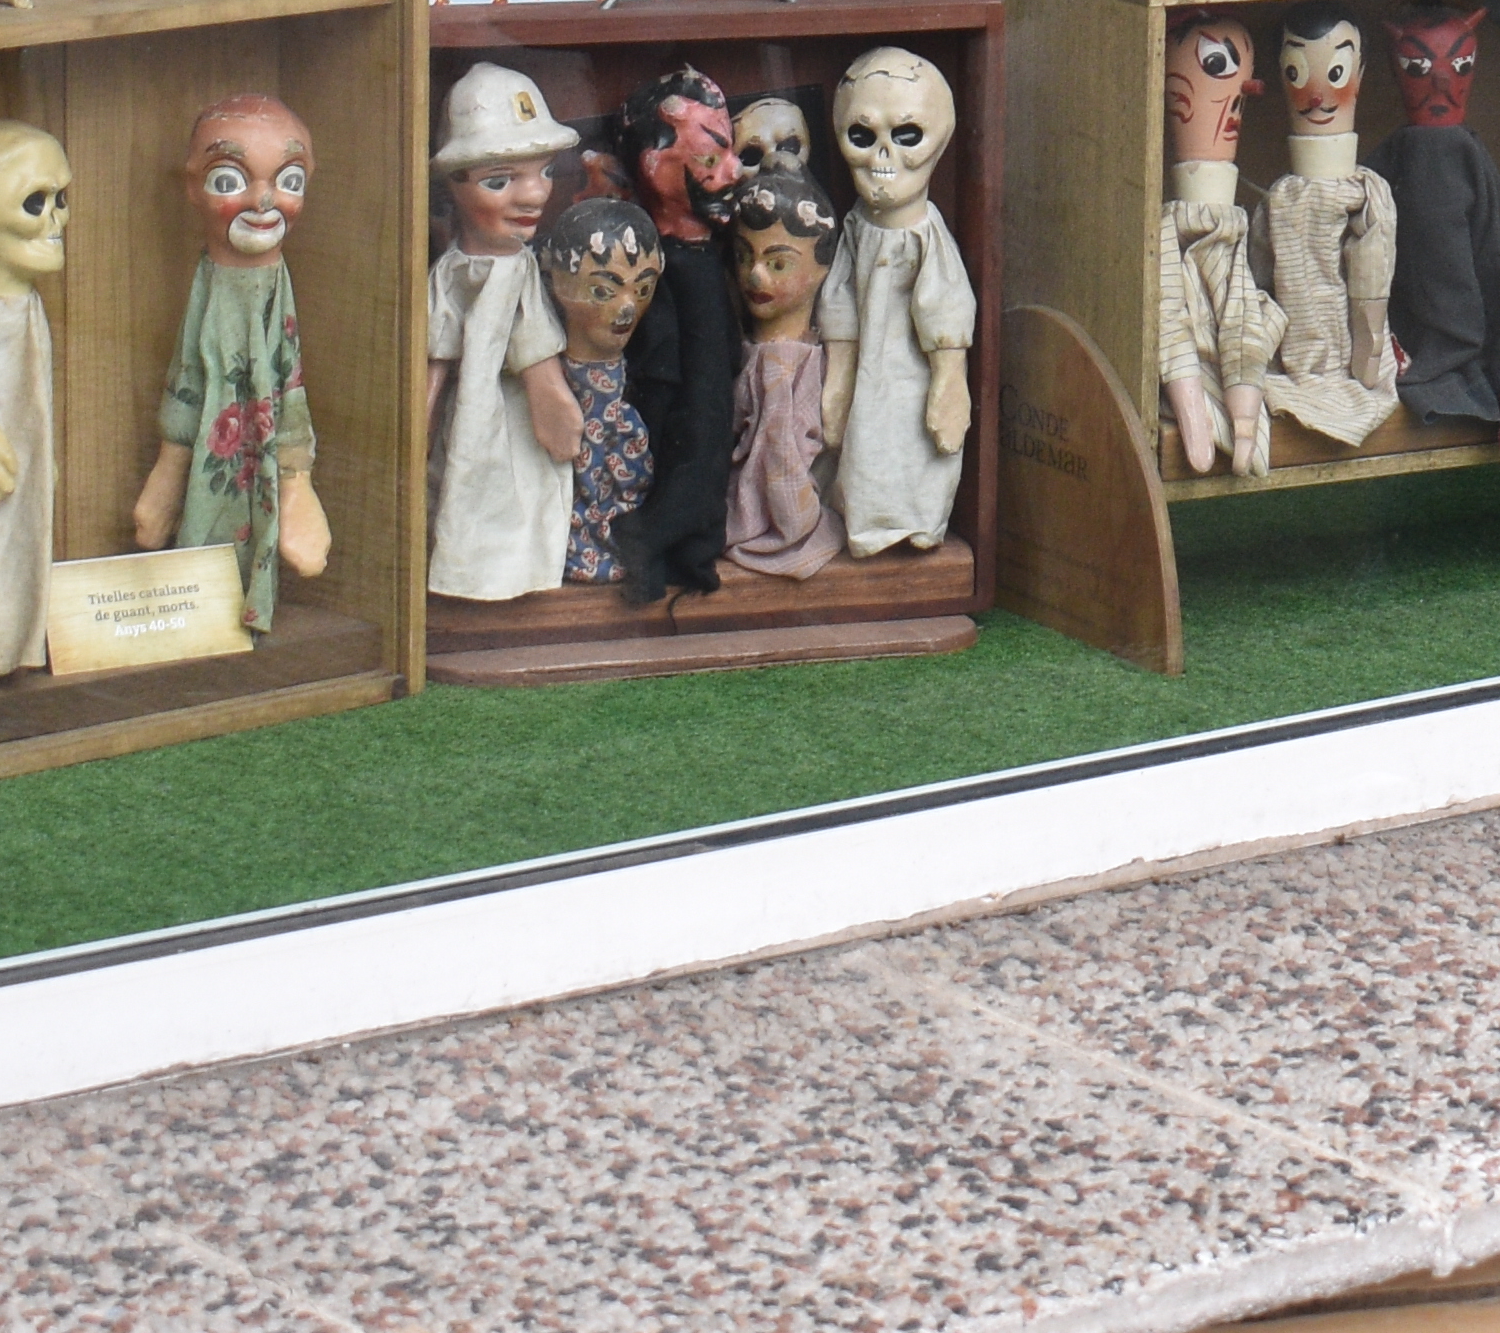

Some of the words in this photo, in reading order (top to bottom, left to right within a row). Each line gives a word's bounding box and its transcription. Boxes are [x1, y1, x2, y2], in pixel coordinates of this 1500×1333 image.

[88, 589, 136, 606] Titelles
[139, 582, 200, 599] catalanes
[94, 609, 110, 622] de
[113, 605, 156, 622] guant,
[158, 600, 199, 615] morts.
[114, 622, 147, 637] Anys
[149, 617, 186, 632] 40-50
